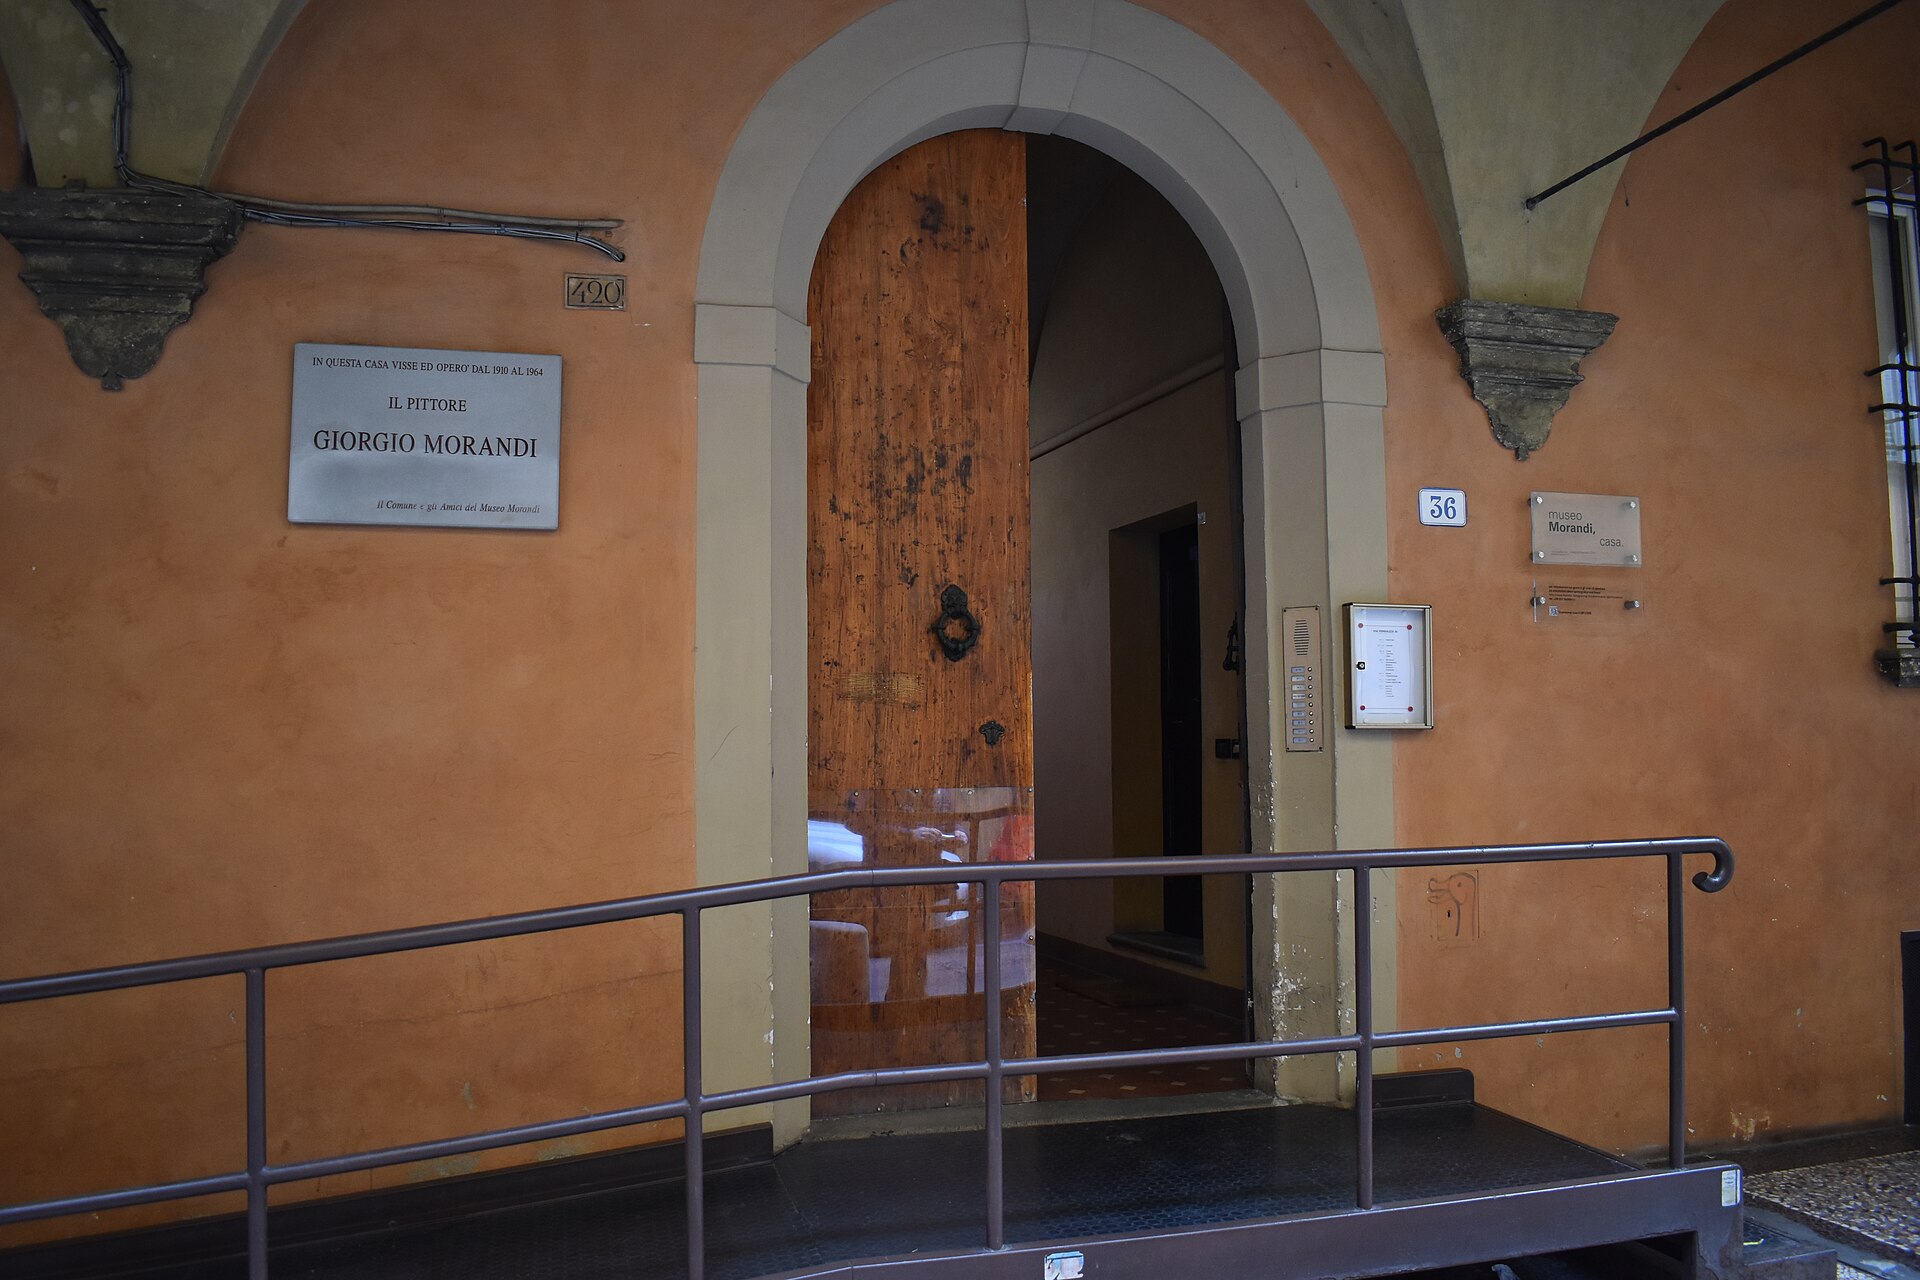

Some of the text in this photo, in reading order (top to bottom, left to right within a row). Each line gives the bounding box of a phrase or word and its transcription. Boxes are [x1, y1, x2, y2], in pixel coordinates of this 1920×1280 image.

[571, 281, 621, 303] 420
[313, 357, 323, 366] IN
[326, 358, 362, 369] QUESTA
[365, 360, 389, 369] CASA
[392, 361, 418, 370] VISSE
[420, 362, 433, 371] ED
[472, 365, 490, 374] DAL
[493, 366, 509, 375] 1910
[511, 367, 524, 375] AL
[527, 367, 543, 376] 1964
[389, 397, 467, 412] IL PITTORE
[314, 430, 538, 458] GIORGIO MORANDI
[386, 500, 416, 509] Comune
[427, 504, 437, 512] gli
[440, 503, 462, 511] Amici
[465, 503, 476, 511] del
[480, 504, 505, 512] Museo
[507, 504, 540, 513] Morandi
[1430, 496, 1457, 519] 36
[1549, 511, 1582, 520] museo
[1549, 522, 1596, 534] Morandi,
[1600, 537, 1624, 547] casa.
